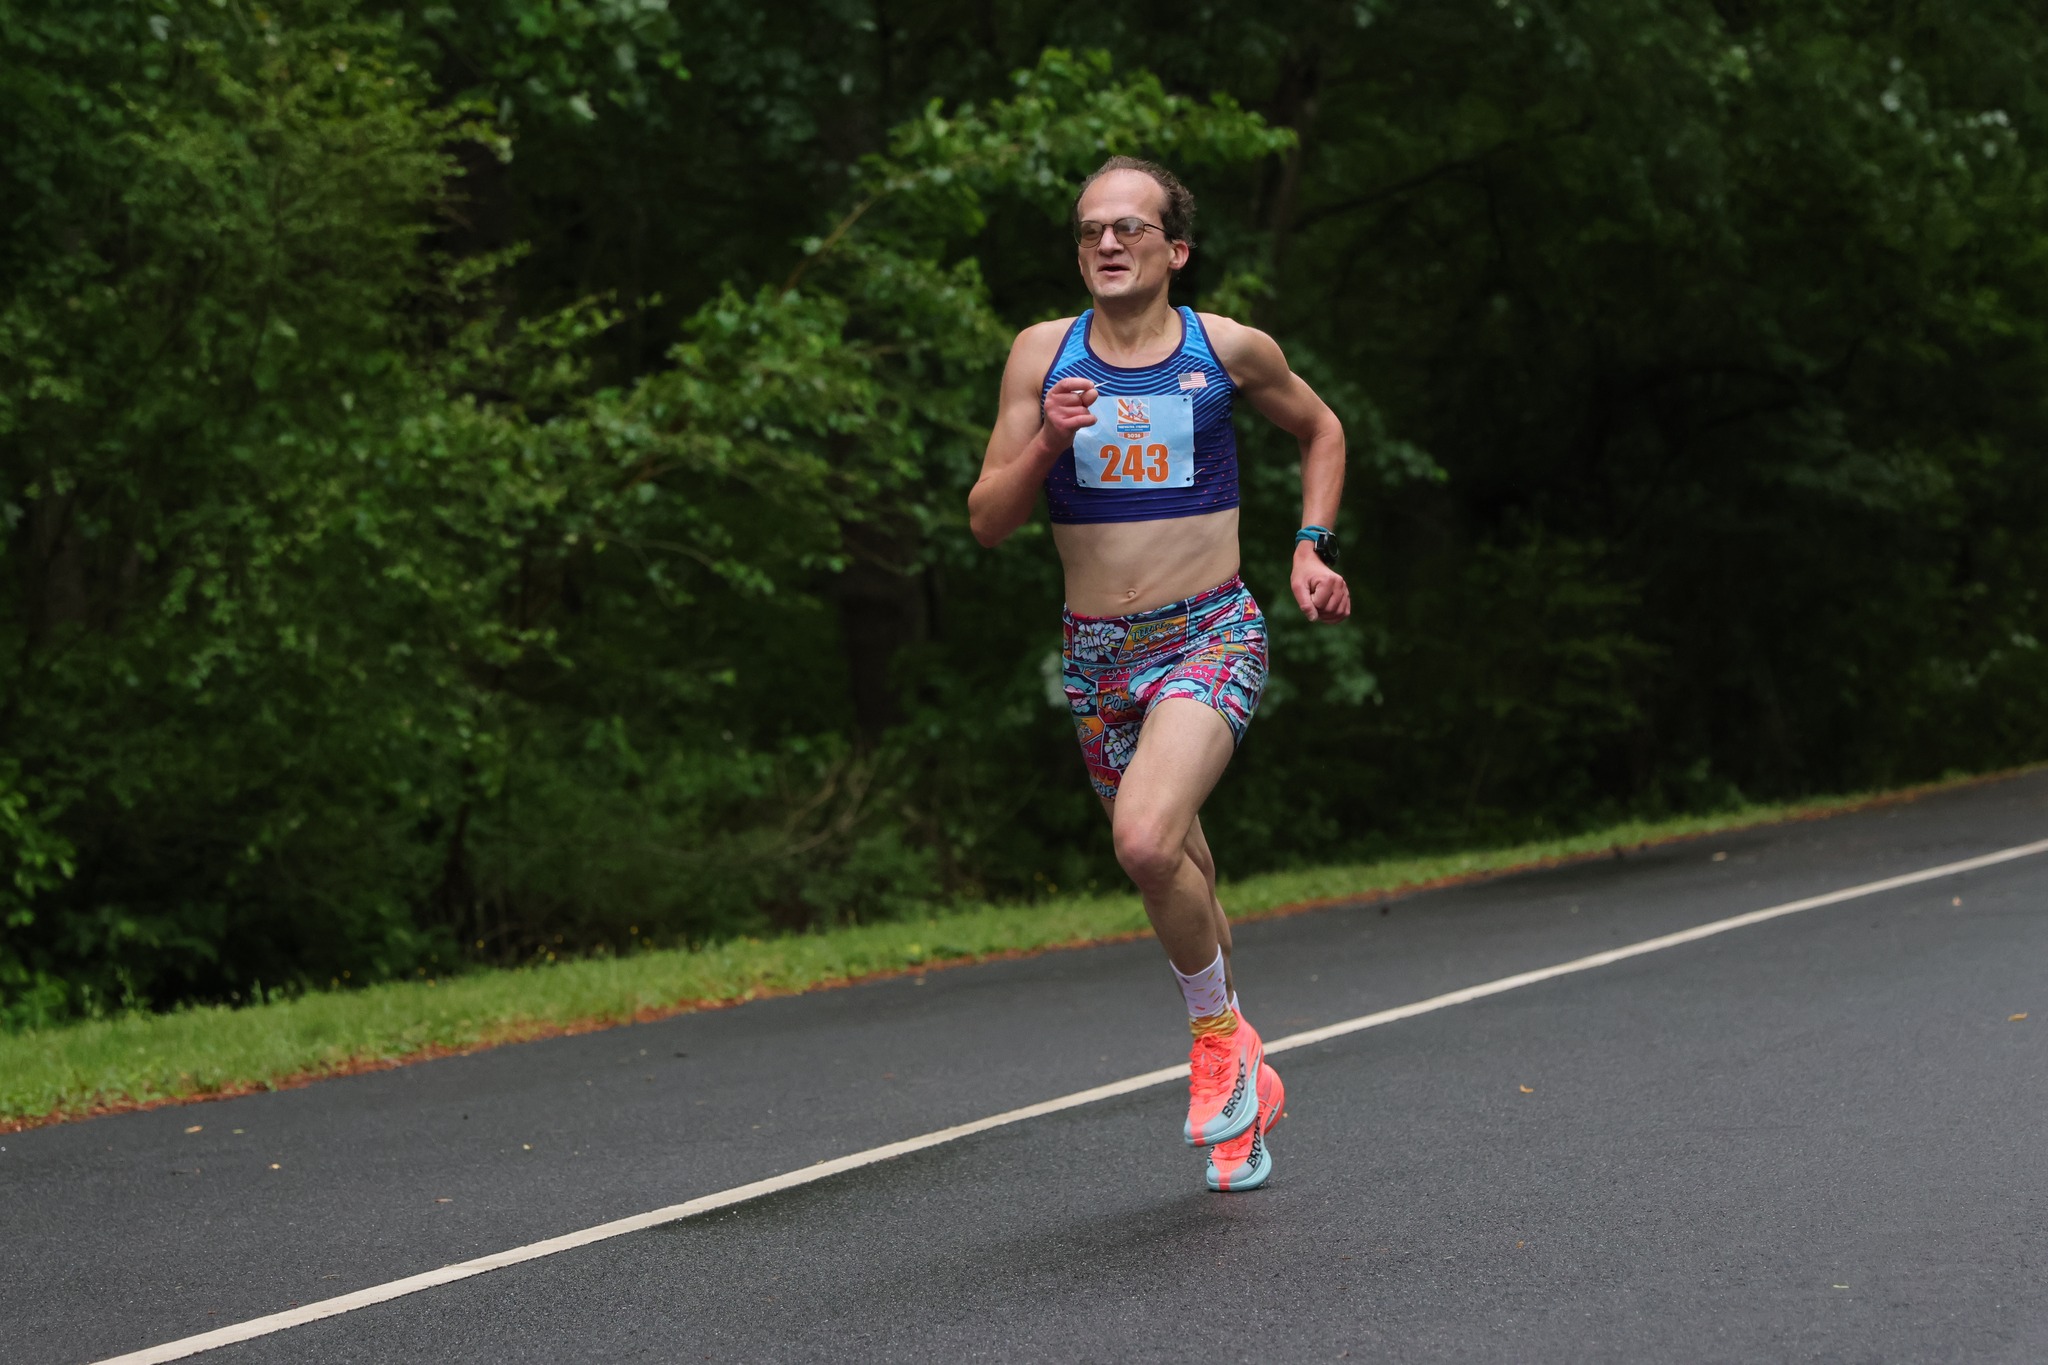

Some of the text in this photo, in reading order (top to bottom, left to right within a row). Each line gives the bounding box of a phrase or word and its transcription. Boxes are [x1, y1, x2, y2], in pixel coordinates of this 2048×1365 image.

[1099, 444, 1169, 482] 243
[1080, 633, 1110, 648] BANG
[1102, 694, 1132, 712] POP
